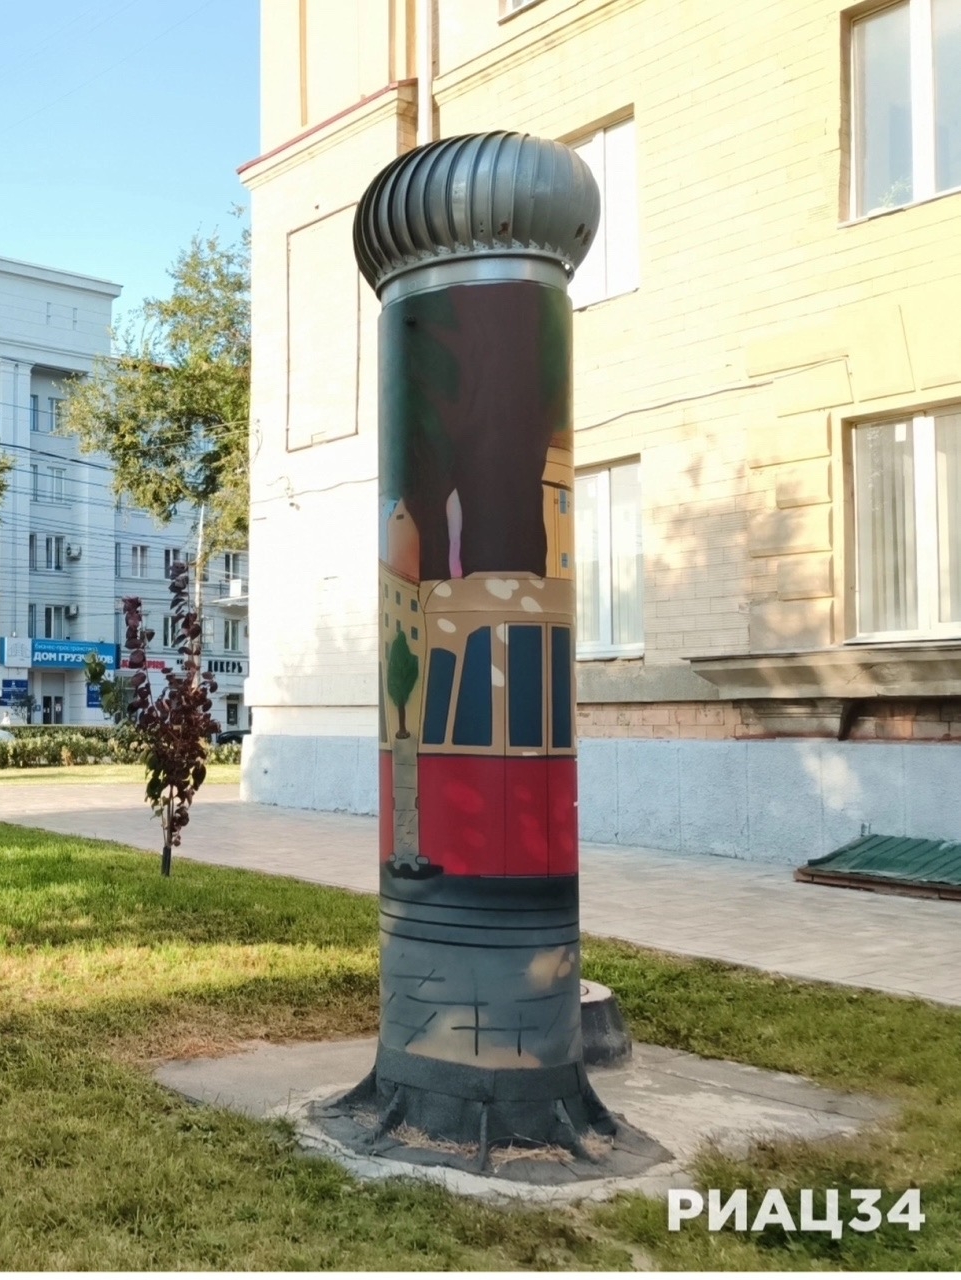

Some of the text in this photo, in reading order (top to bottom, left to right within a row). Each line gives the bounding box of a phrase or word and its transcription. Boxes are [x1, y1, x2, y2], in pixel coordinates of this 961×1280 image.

[33, 651, 114, 664] ДОМ ГРУЗЧКОВ
[208, 660, 243, 673] ДОКЕРЪ
